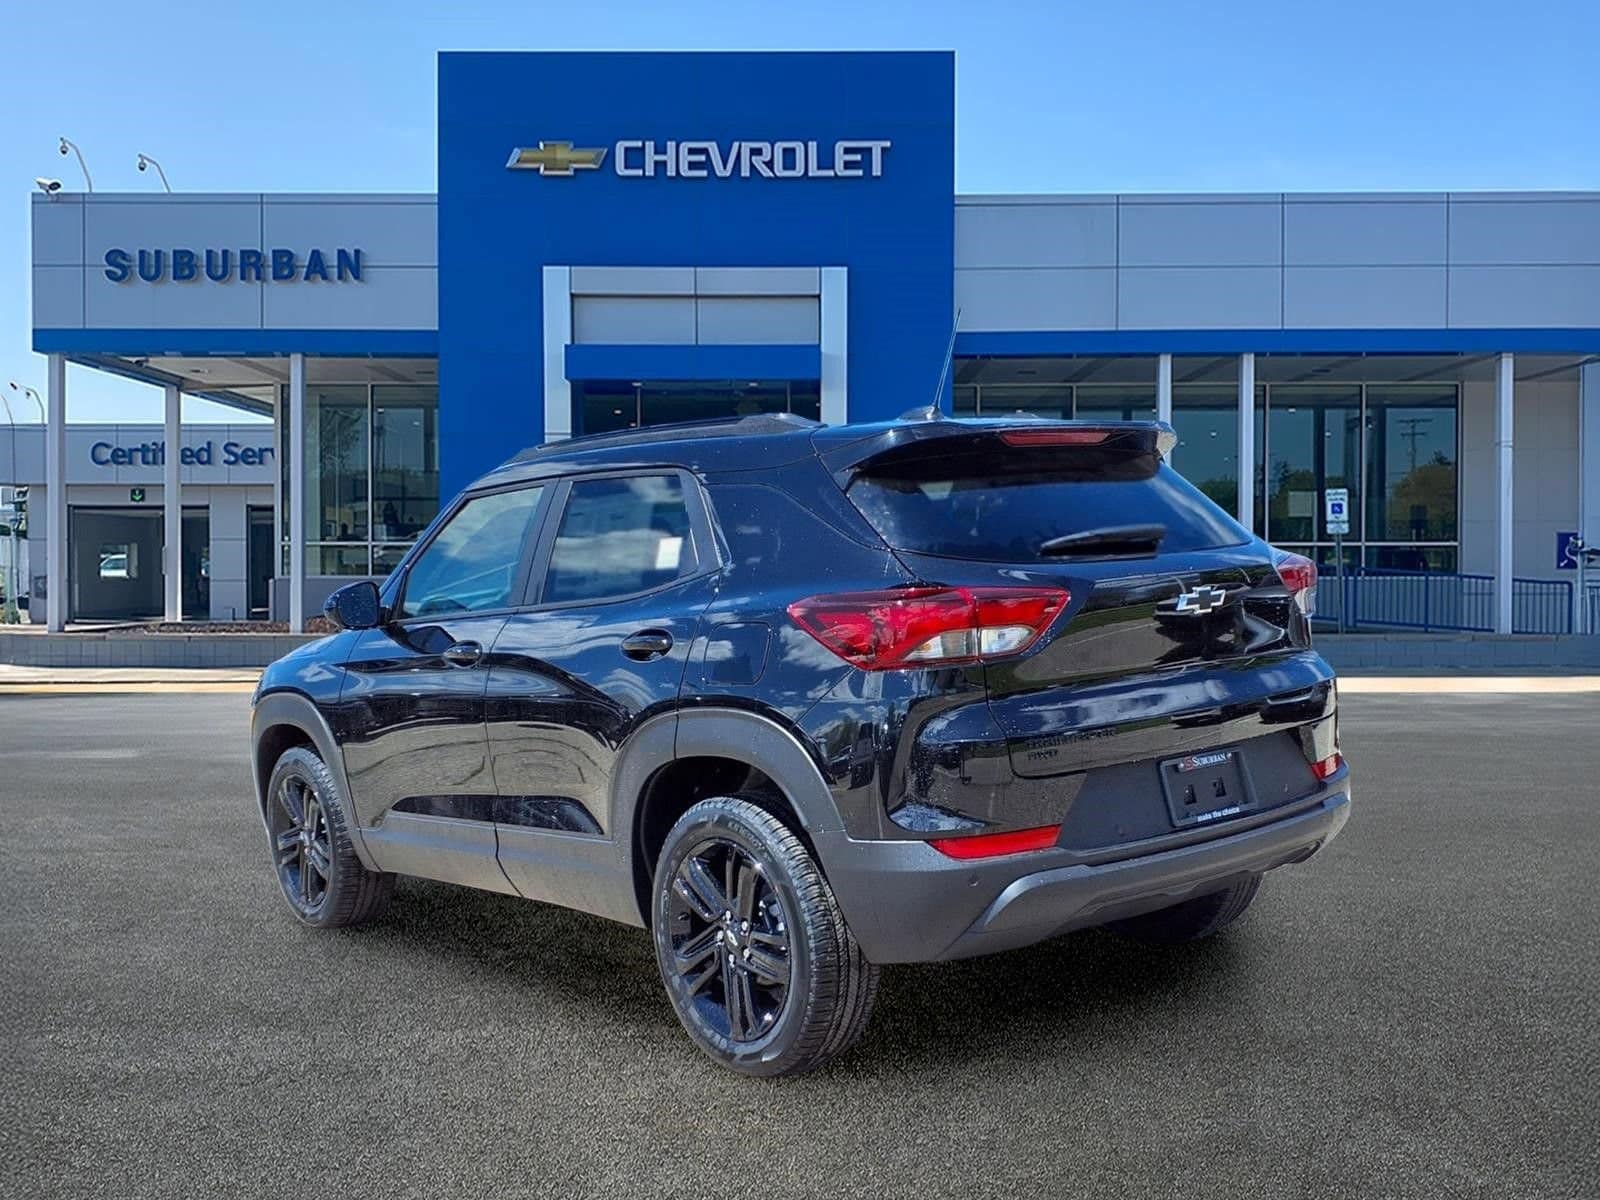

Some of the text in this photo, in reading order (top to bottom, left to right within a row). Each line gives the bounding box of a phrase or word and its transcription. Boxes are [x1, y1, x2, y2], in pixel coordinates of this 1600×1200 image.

[615, 140, 891, 178] CHEVROLET
[104, 249, 362, 282] SUBURBAN
[91, 441, 212, 466] Certifed
